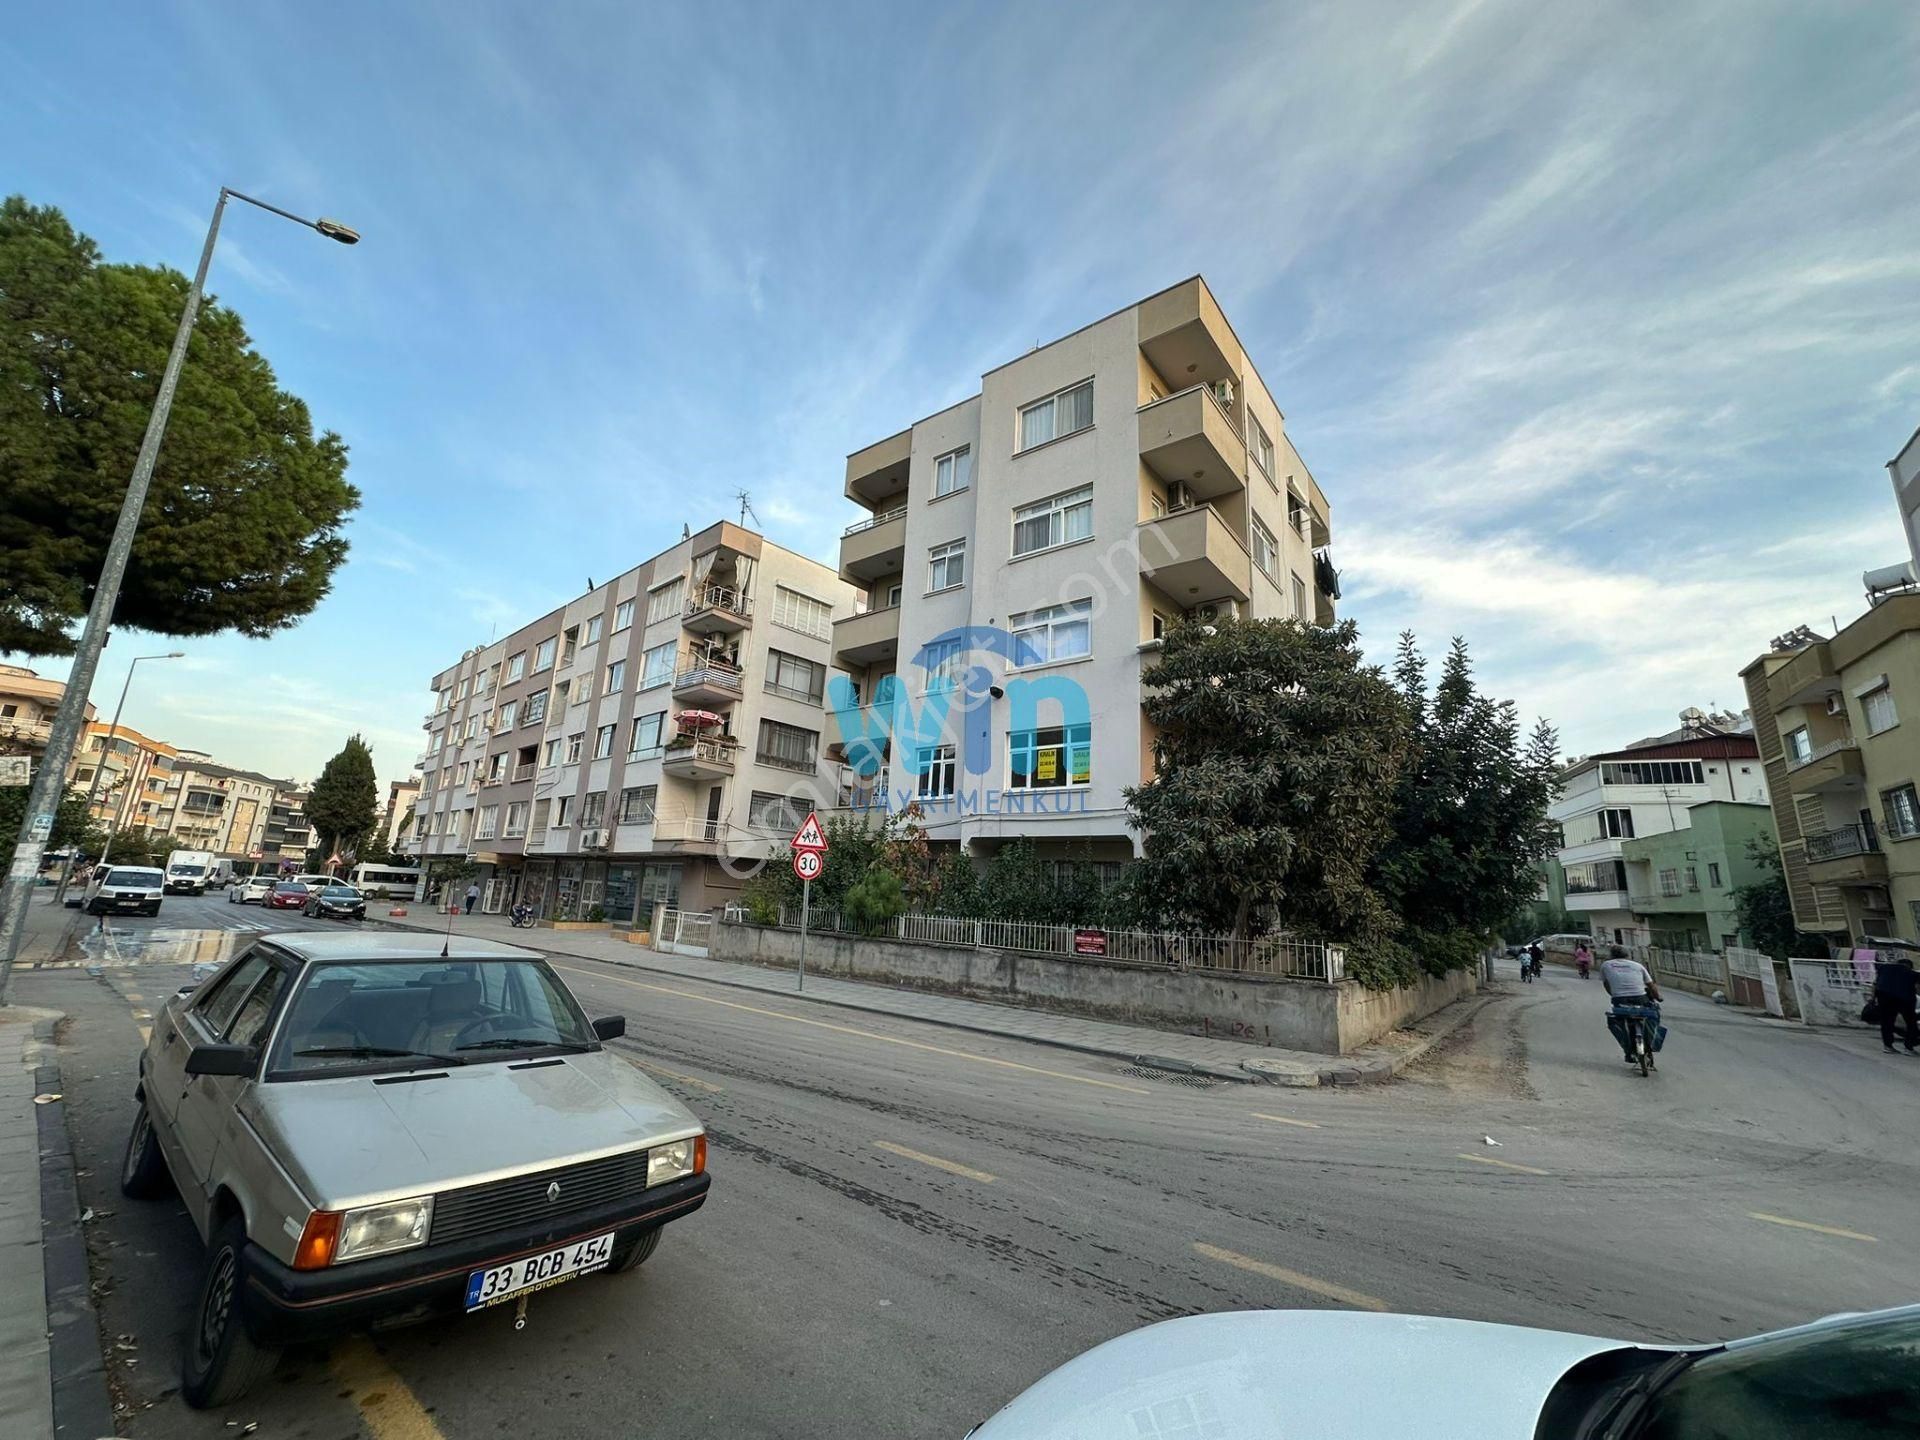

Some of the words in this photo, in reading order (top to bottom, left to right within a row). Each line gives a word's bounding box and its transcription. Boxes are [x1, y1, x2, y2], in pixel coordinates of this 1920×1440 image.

[800, 857, 817, 871] 30
[483, 1267, 514, 1297] 33
[522, 1251, 565, 1284] BCB
[573, 1237, 608, 1267] 454
[469, 1290, 480, 1300] TR
